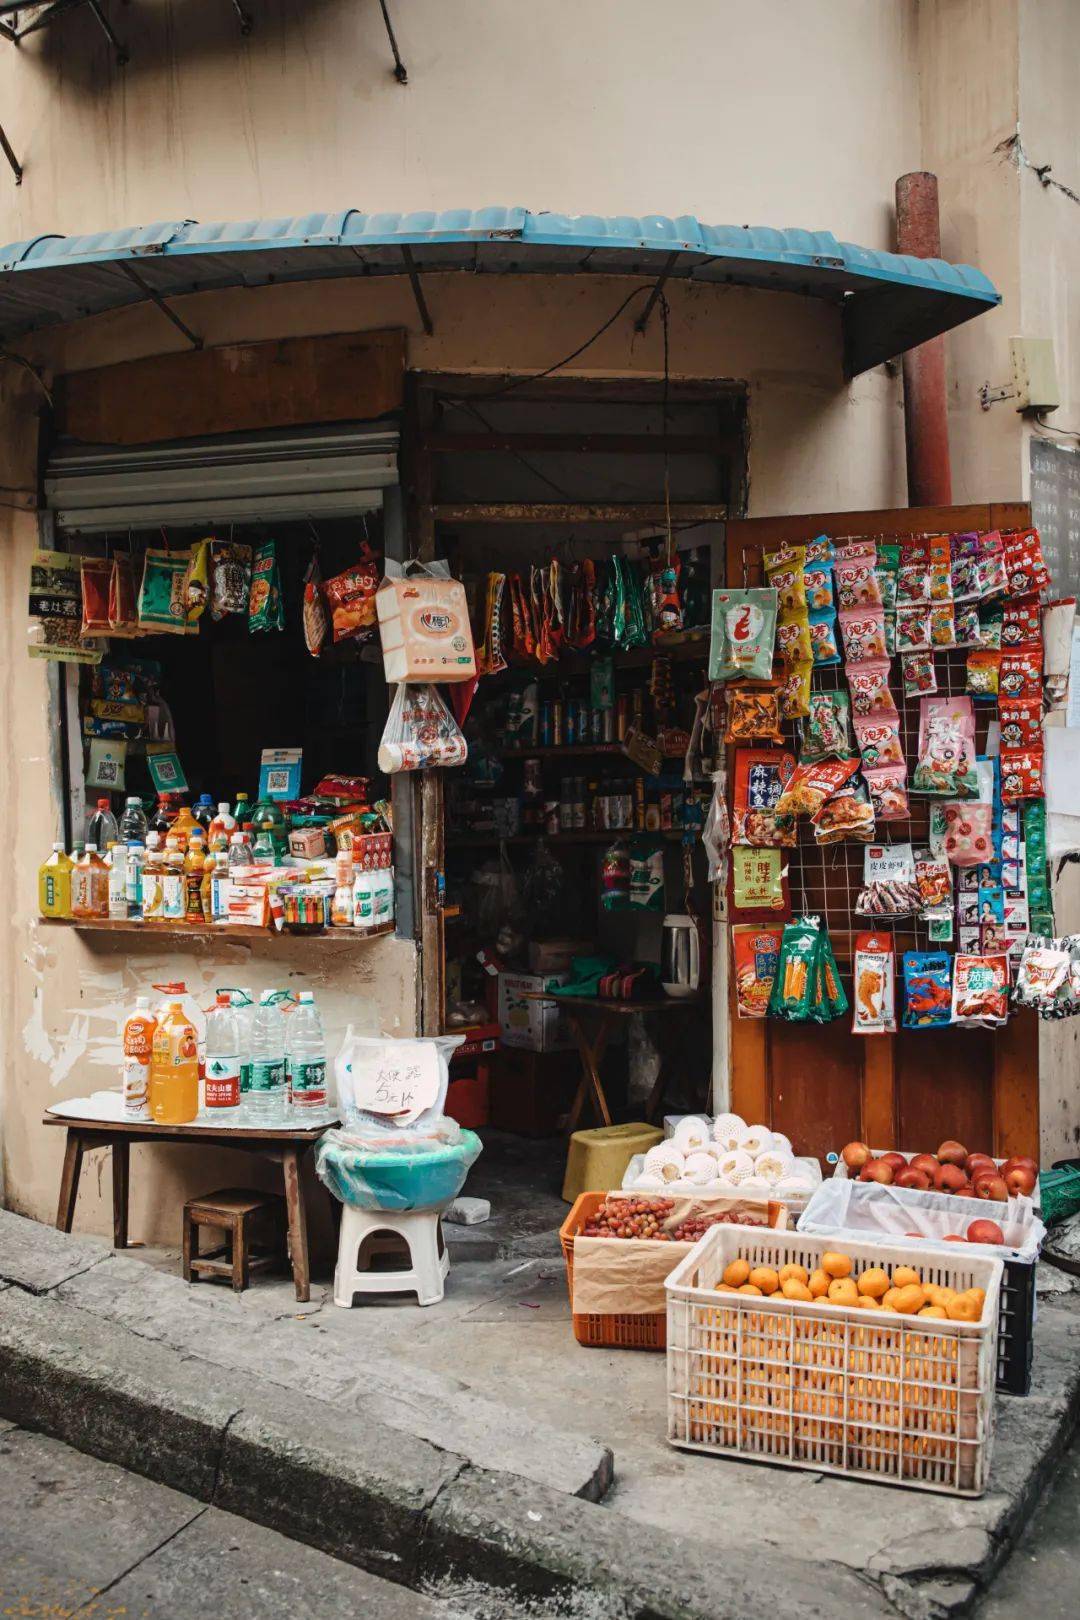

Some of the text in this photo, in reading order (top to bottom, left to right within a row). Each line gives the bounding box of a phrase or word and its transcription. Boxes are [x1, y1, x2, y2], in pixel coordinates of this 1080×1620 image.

[839, 566, 869, 586] 泡芙
[846, 618, 878, 639] 泡芙
[861, 726, 892, 746] 泡芙
